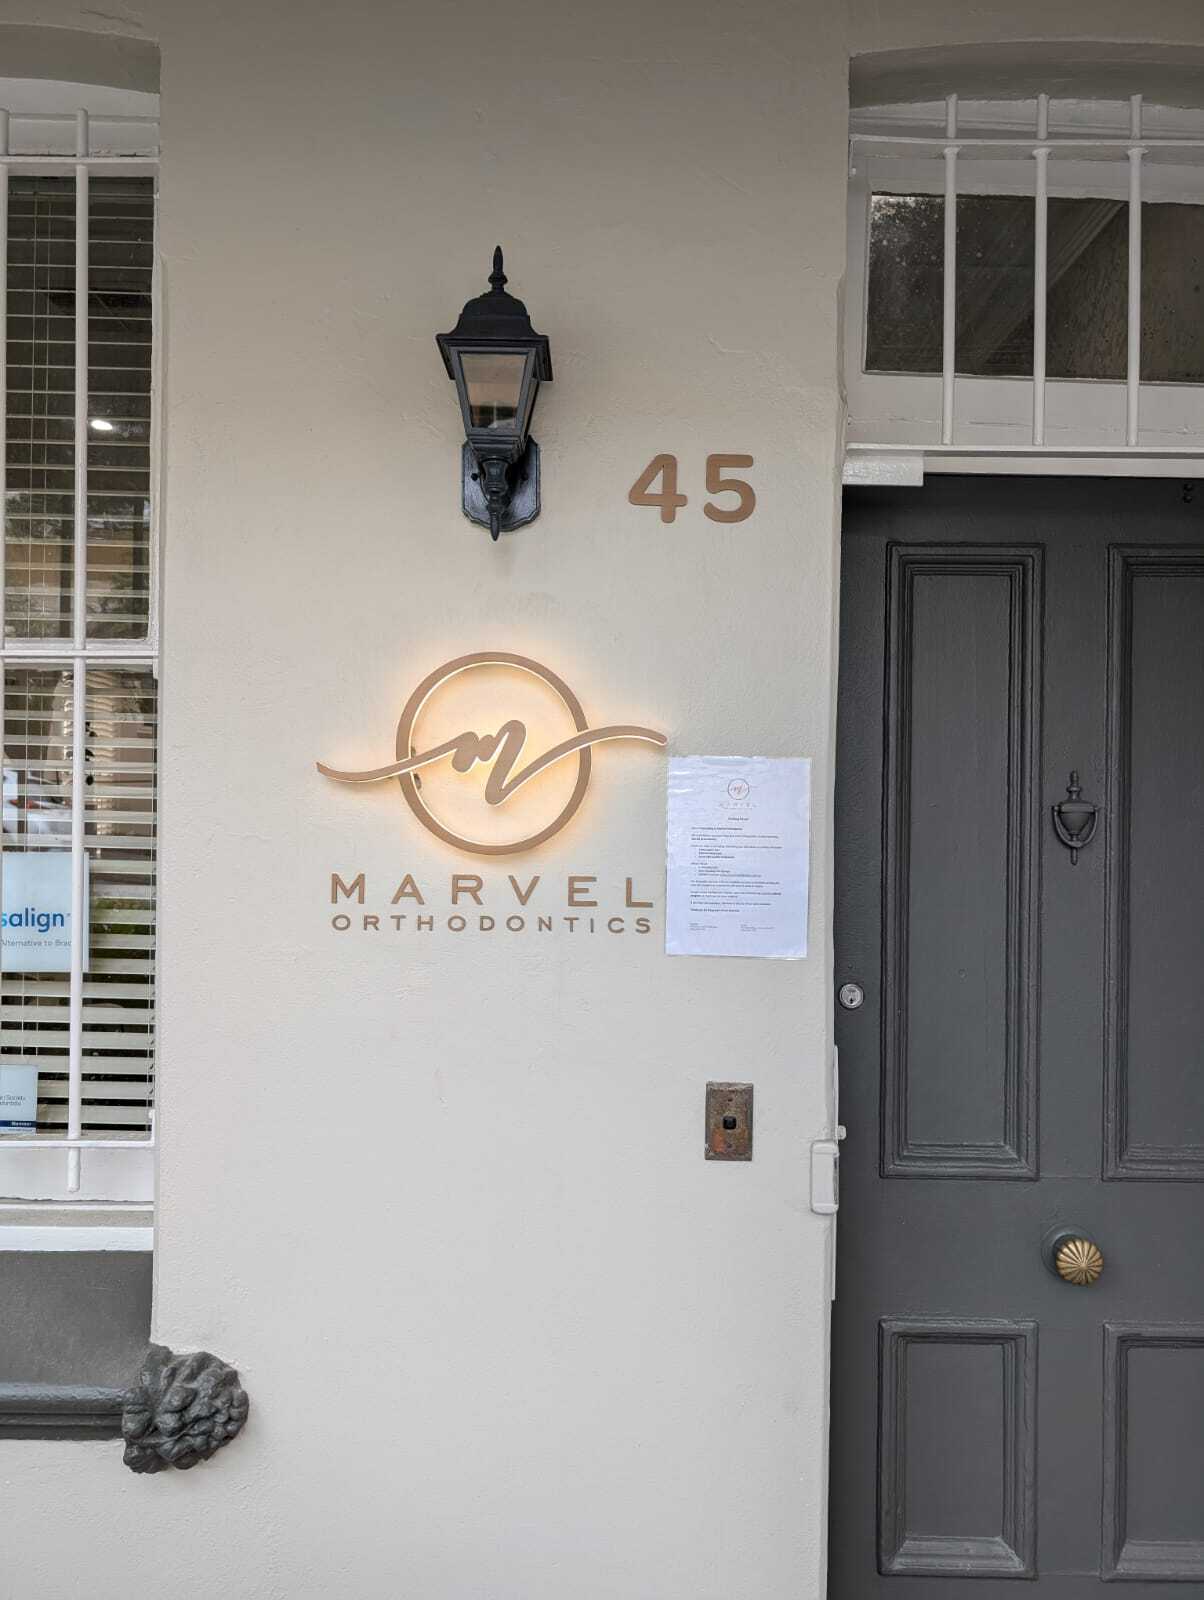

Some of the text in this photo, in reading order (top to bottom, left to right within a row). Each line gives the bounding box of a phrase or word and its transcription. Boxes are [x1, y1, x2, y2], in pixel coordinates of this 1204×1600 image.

[628, 453, 757, 524] 45
[331, 873, 654, 909] MARVEL
[331, 914, 651, 934] ORTHODONTICS
[44, 938, 53, 947] to
